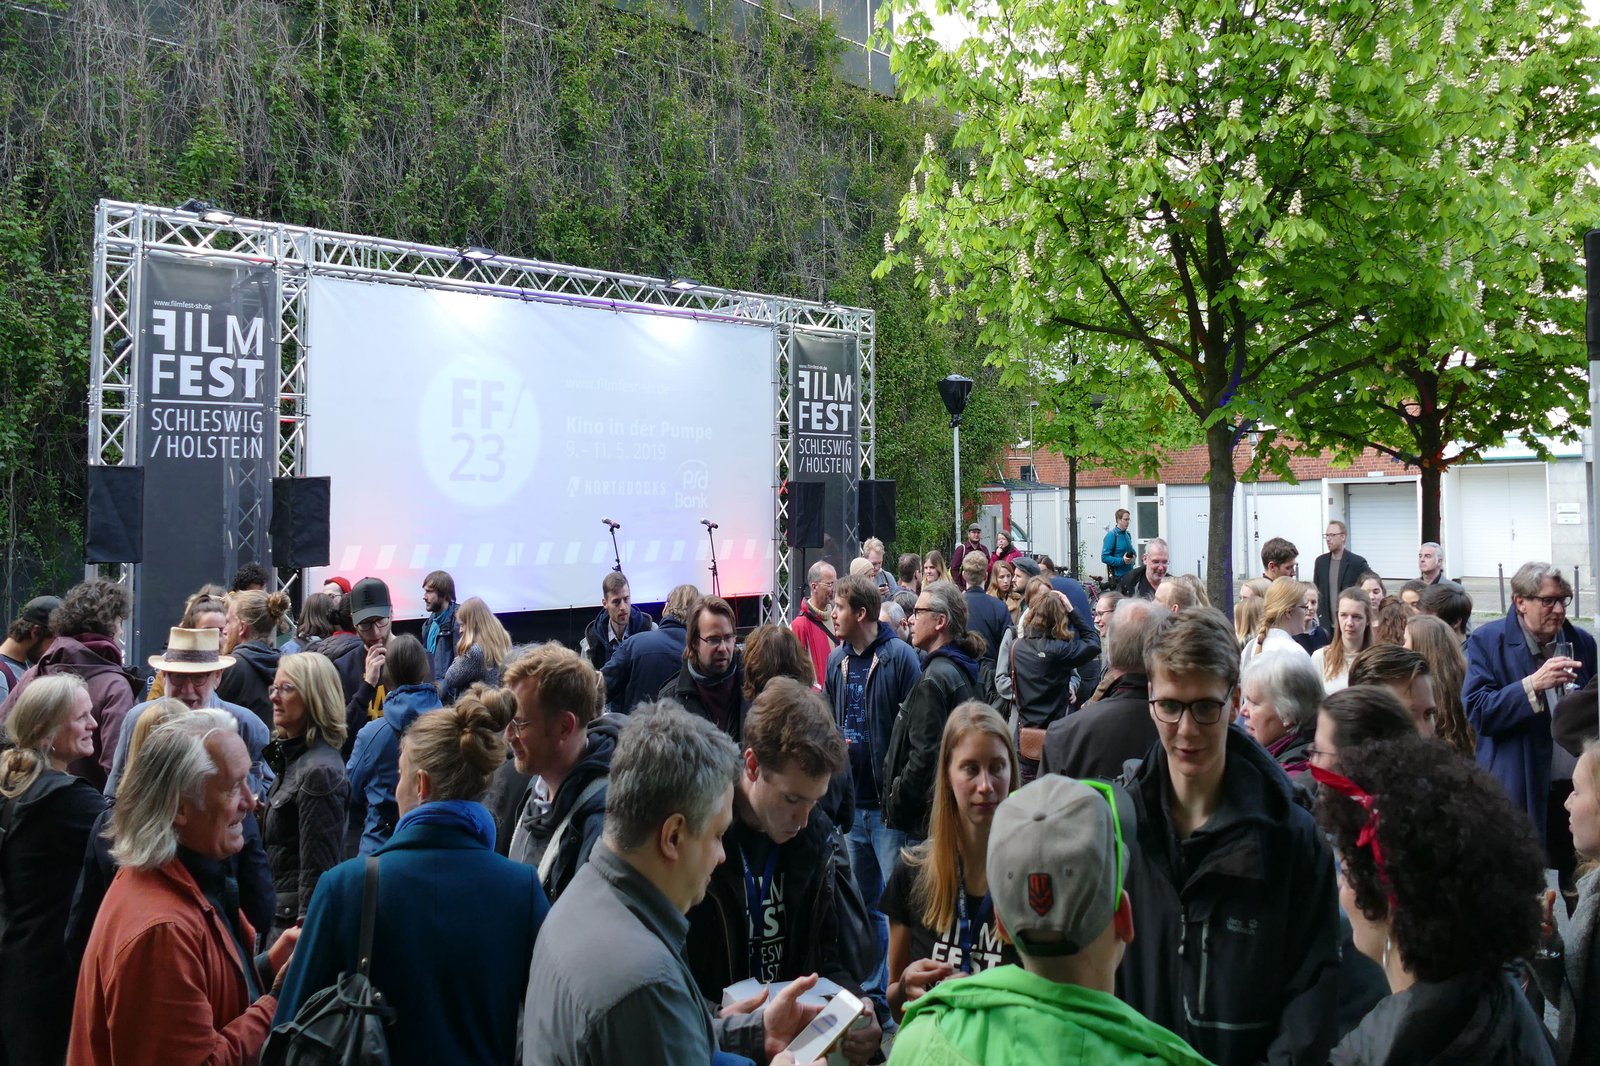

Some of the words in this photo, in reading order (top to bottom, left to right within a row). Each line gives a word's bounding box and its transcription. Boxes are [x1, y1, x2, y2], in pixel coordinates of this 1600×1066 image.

[153, 300, 212, 310] www.filmfest-sh.de
[152, 308, 264, 356] FILM
[152, 353, 265, 399] FEST
[798, 370, 852, 402] FILM
[151, 408, 263, 433] SCHLESWIG
[798, 400, 852, 432] FEST
[566, 416, 604, 435] Kino
[609, 417, 624, 436] in
[630, 420, 656, 437] der
[661, 421, 713, 443] Pumpe
[150, 435, 263, 459] /HOLSTEIN
[449, 431, 507, 484] 23
[633, 443, 666, 461] 2019
[798, 438, 852, 456] SCHLESWIG
[798, 457, 852, 474] /HOLSTEIN
[674, 492, 708, 509] Bank
